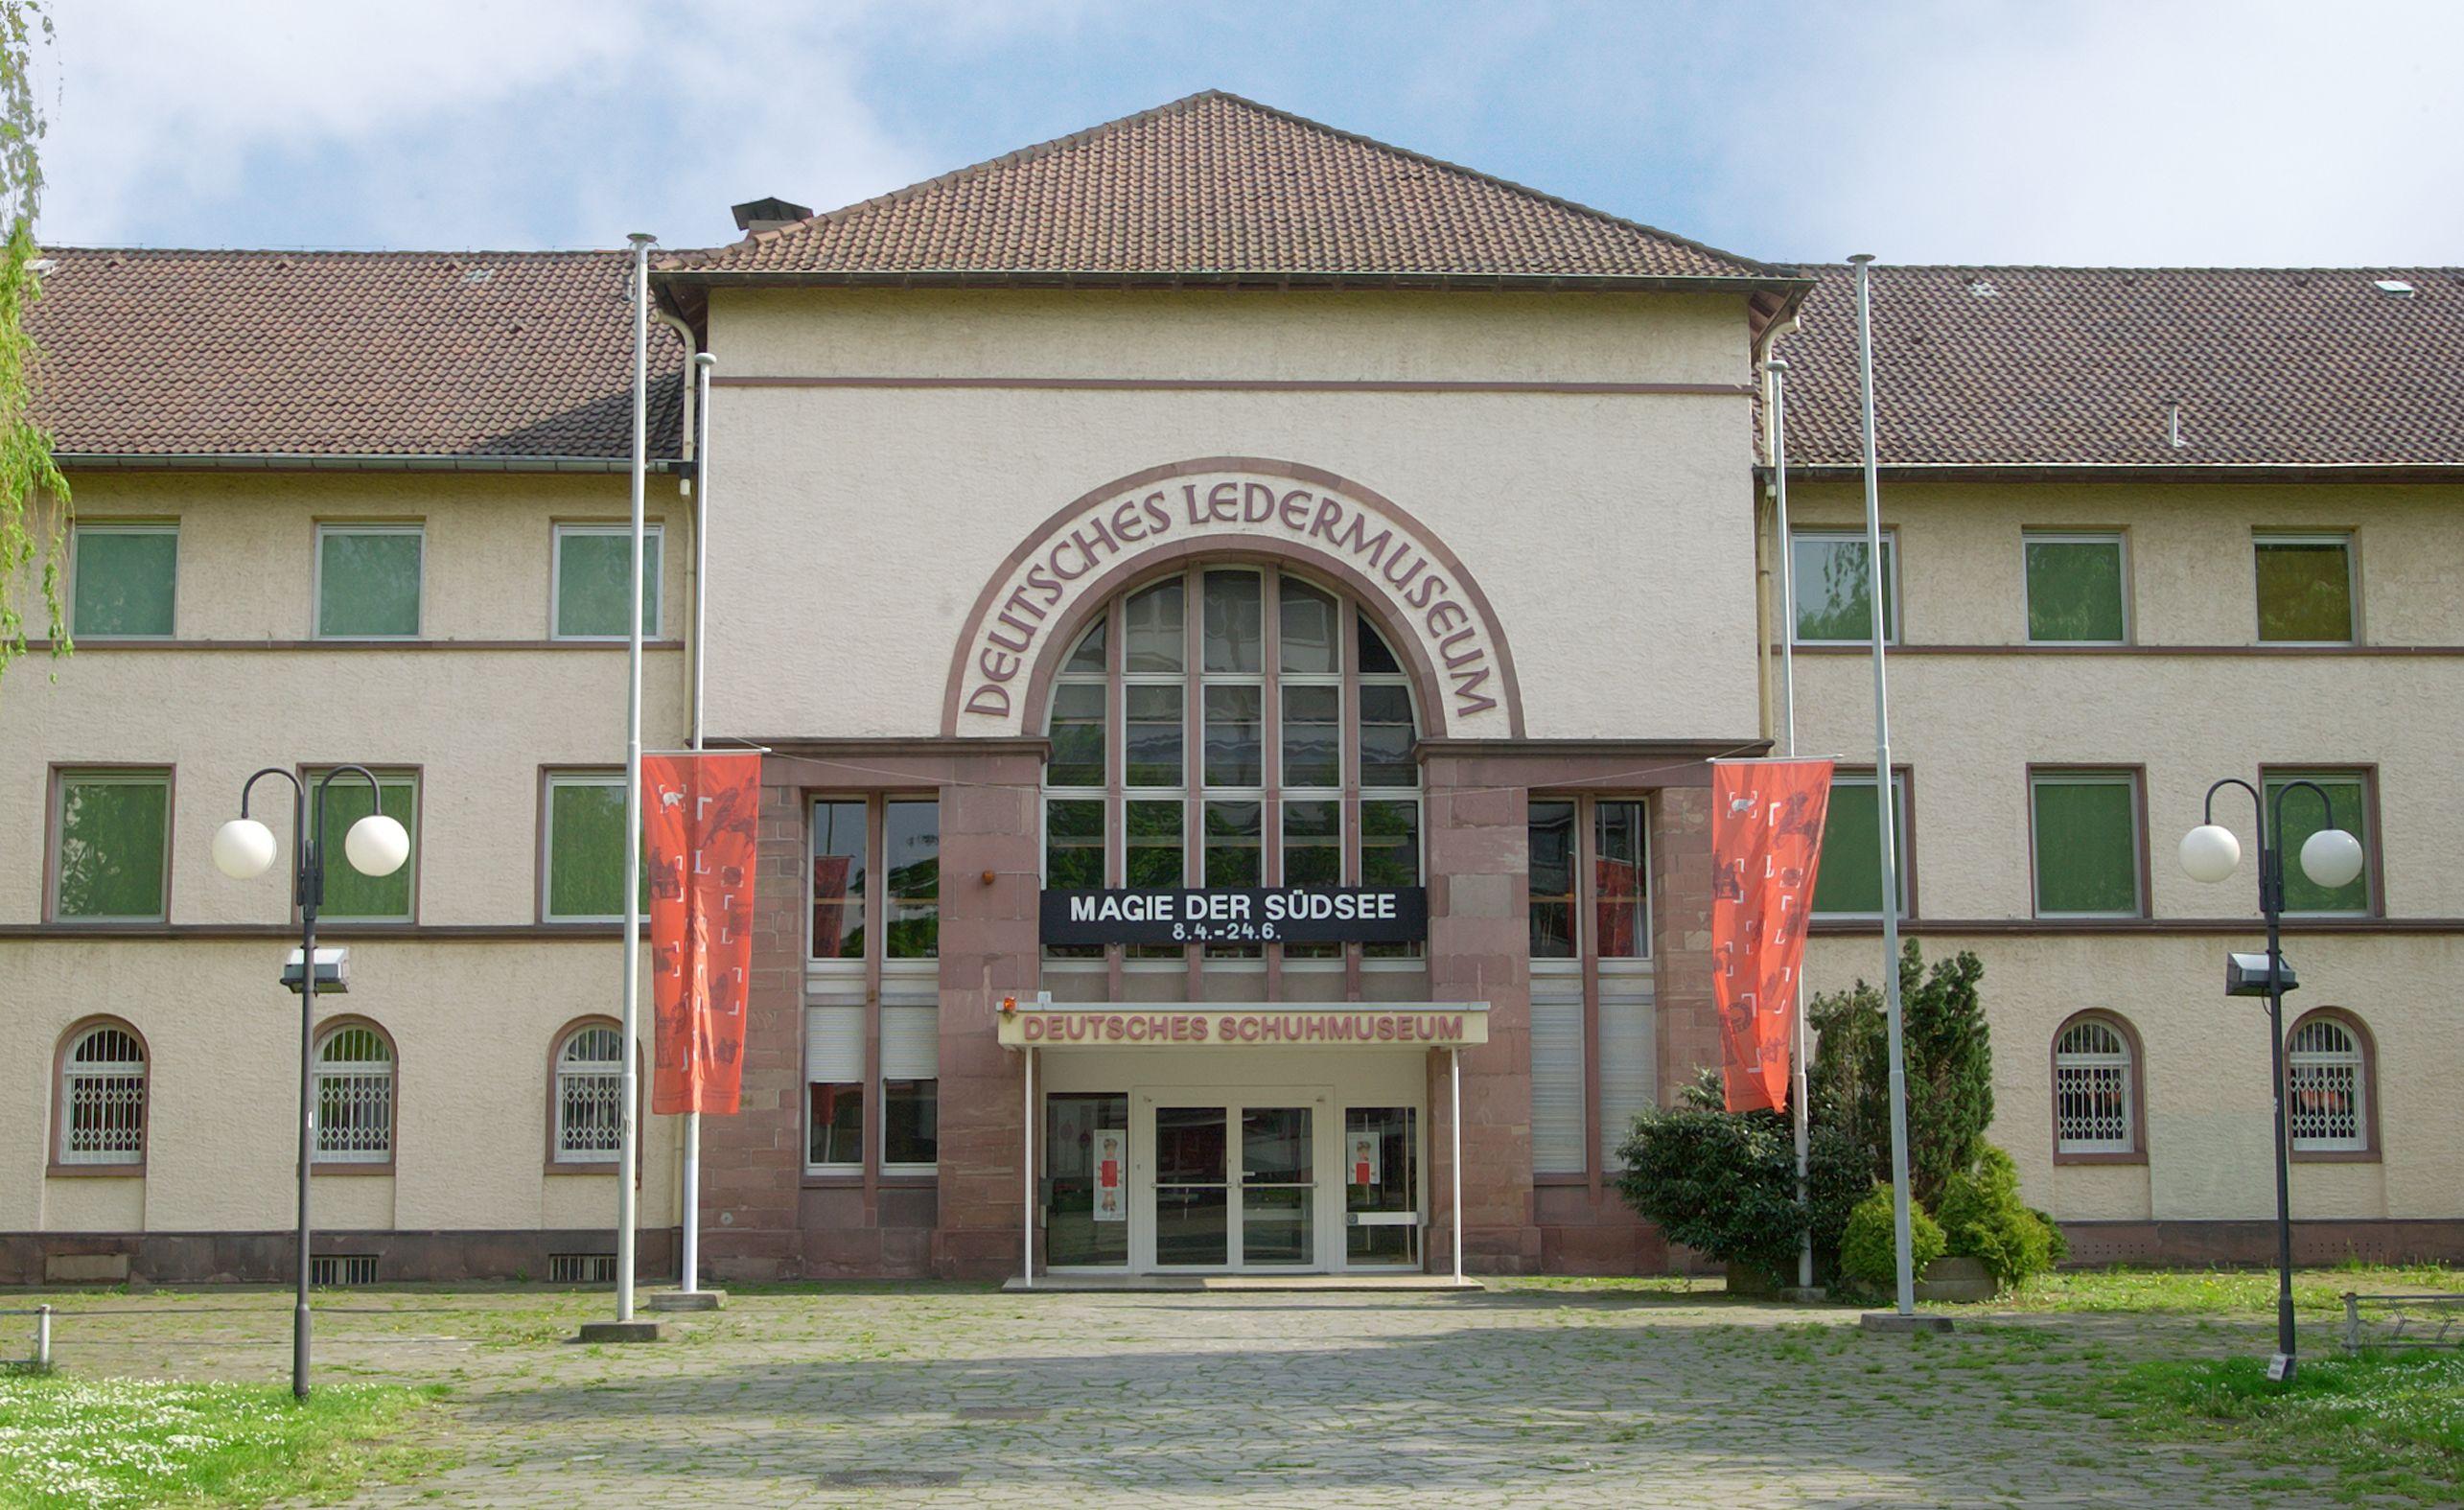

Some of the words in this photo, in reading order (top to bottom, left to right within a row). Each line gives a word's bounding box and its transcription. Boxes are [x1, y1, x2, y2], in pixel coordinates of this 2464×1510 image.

[965, 491, 1172, 718] DEUTSCHES
[1182, 482, 1498, 718] LEDERMUSEUM
[1070, 895, 1174, 921] MAGIE
[1185, 894, 1250, 920] DER
[1265, 889, 1396, 920] SÜDSEE
[1172, 922, 1281, 941] 8.4.-24.6.
[1024, 1015, 1209, 1040] DEUTSCHES
[1219, 1015, 1463, 1041] SCHUHMUSEUM
